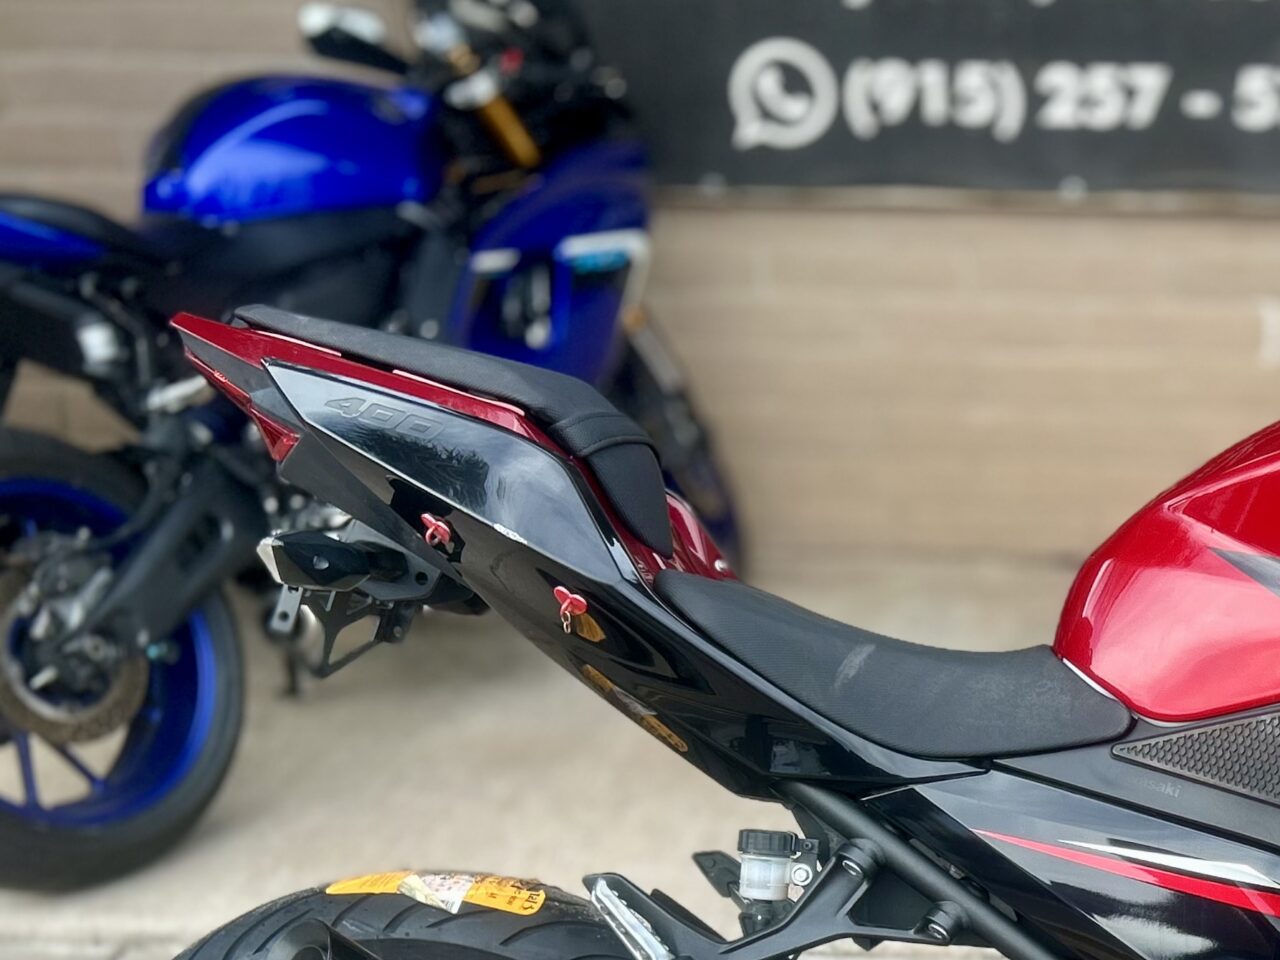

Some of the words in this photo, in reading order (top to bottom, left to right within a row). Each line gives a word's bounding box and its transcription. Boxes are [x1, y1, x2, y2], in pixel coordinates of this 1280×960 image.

[843, 58, 1027, 141] (915)
[1036, 62, 1171, 131] 257
[324, 396, 446, 440] 400
